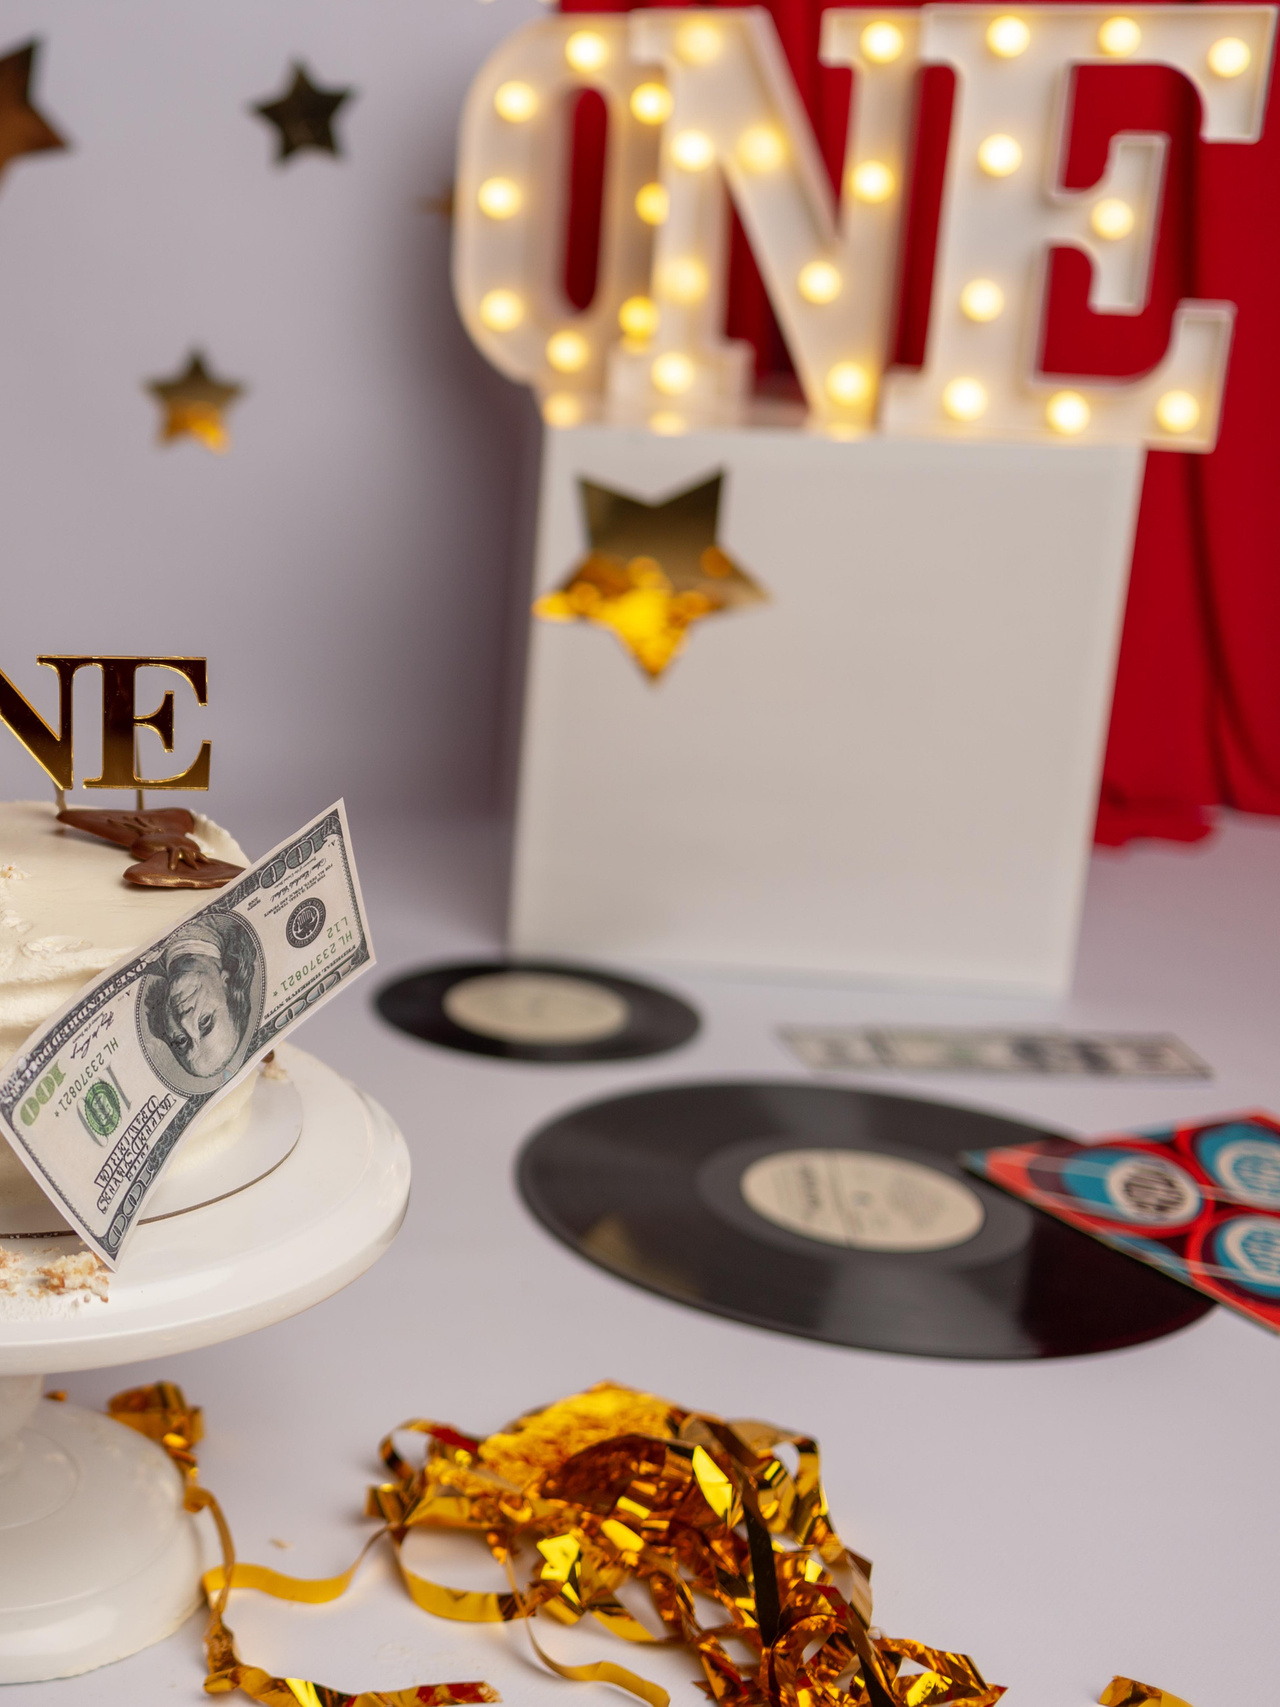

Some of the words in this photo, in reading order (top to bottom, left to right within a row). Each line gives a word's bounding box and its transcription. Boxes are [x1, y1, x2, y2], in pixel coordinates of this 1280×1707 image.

[453, 4, 1279, 453] ONE
[255, 823, 329, 893] 100
[325, 916, 349, 939] L12
[337, 929, 353, 947] HL
[114, 960, 147, 988] ONE
[271, 955, 355, 1032] 100
[280, 942, 337, 992] 23370821
[51, 983, 115, 1045] HUNDRED
[264, 1000, 286, 1020] NOTE
[103, 1036, 119, 1052] HL
[18, 1059, 68, 1127] 100
[57, 1051, 105, 1112] 23370821
[107, 1161, 153, 1249] 100
